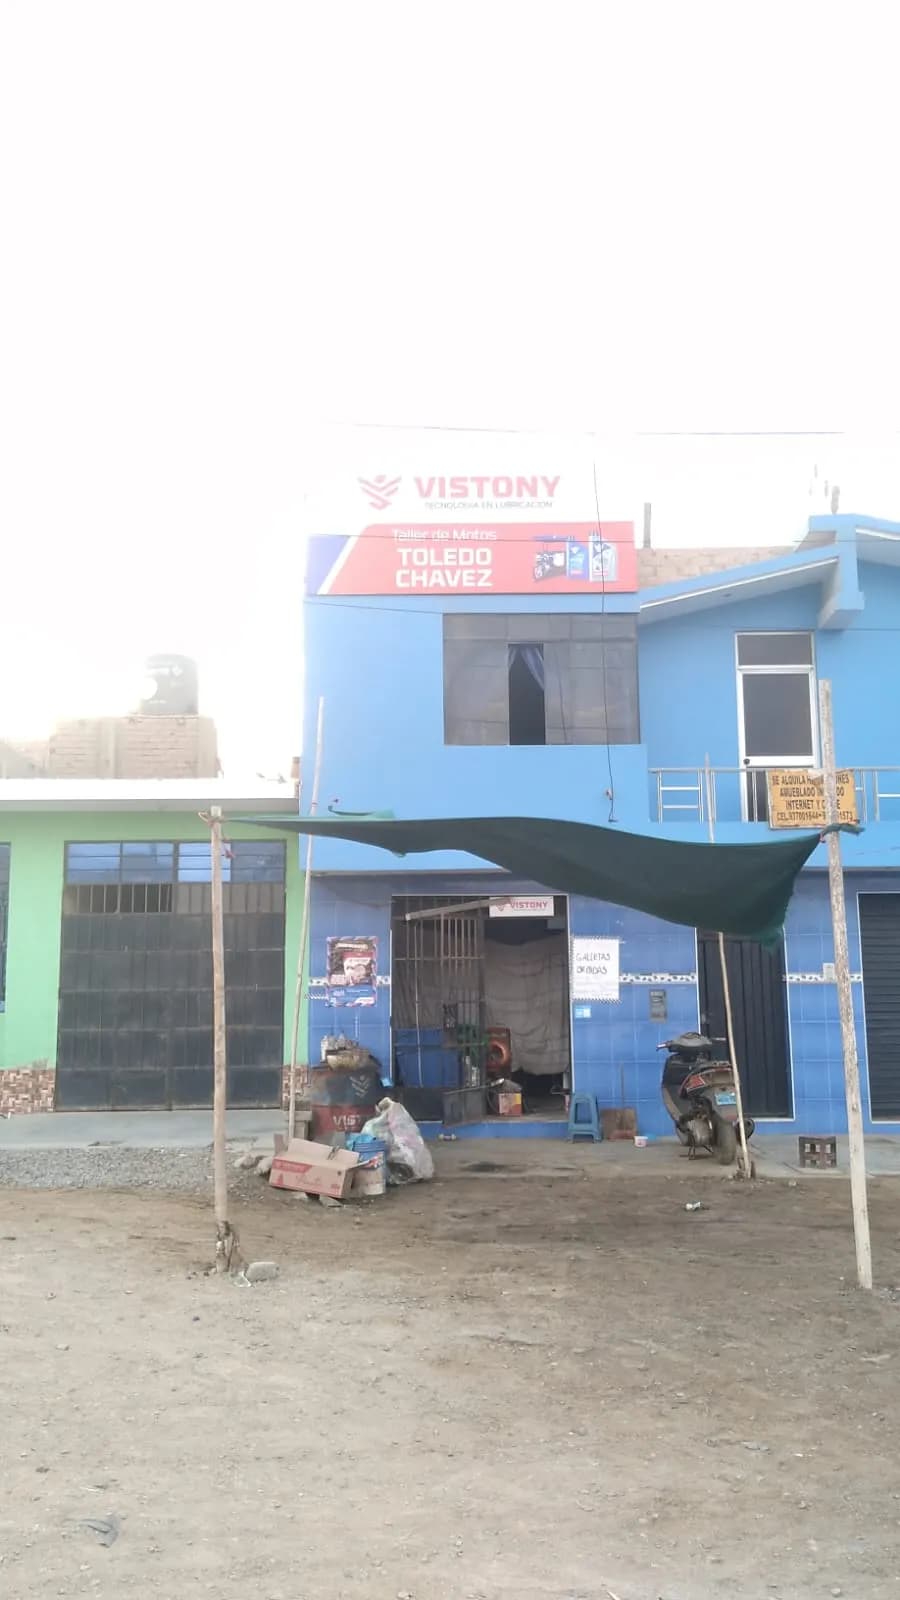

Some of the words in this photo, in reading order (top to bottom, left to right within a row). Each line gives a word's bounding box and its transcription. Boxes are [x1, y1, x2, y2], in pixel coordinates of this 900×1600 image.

[413, 475, 560, 499] VISTONY
[392, 528, 428, 541] Taller
[432, 528, 450, 541] de
[453, 529, 497, 541] Motos
[397, 547, 492, 566] TOLEDO
[395, 569, 492, 587] CHAVEZ
[781, 775, 806, 785] ALQUILA
[780, 787, 815, 797] AMUEBLADO
[785, 800, 814, 810] INTERNET
[510, 900, 548, 909] VISTONY
